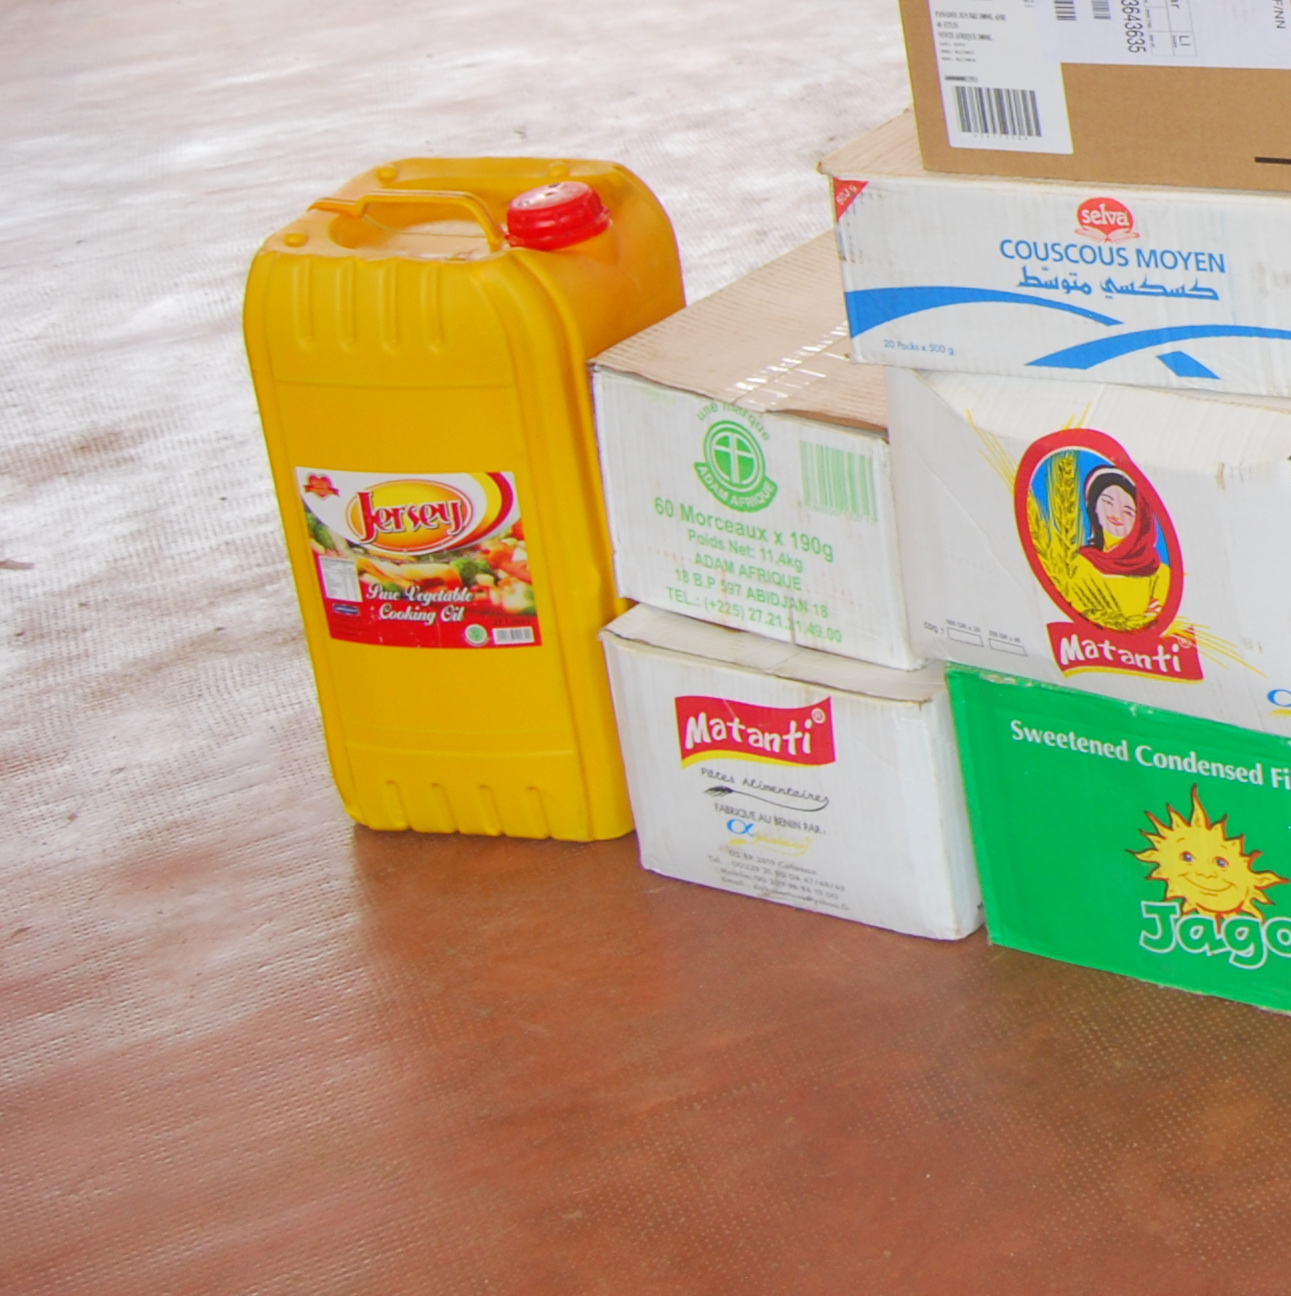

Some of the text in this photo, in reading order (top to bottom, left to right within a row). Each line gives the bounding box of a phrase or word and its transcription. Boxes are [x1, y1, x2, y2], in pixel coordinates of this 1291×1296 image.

[1081, 203, 1130, 226] selva
[1000, 239, 1226, 274] COUSCOUS MOYEN
[883, 339, 895, 348] 20
[929, 343, 946, 353] 500
[699, 465, 775, 508] ADAM AFRIQUE
[355, 490, 463, 544] Jersey
[654, 496, 834, 563] 60 Morceaux x 190g
[687, 529, 725, 550] Poids
[759, 547, 803, 573] 11.4kg
[694, 552, 802, 591] ADAM AFRIQUE
[366, 582, 475, 607] Pure Vegetable
[675, 568, 690, 585] 18
[720, 579, 742, 597] 597
[746, 587, 809, 614] ABIDJAN
[813, 602, 829, 619] 18
[379, 603, 437, 626] Cooking
[441, 605, 465, 622] Oil
[1059, 633, 1182, 673] Matanti
[685, 711, 813, 756] Matanti
[1010, 719, 1128, 762] Sweetened
[1135, 744, 1264, 787] Condensed
[758, 812, 772, 824] AU
[774, 816, 801, 830] BENIN
